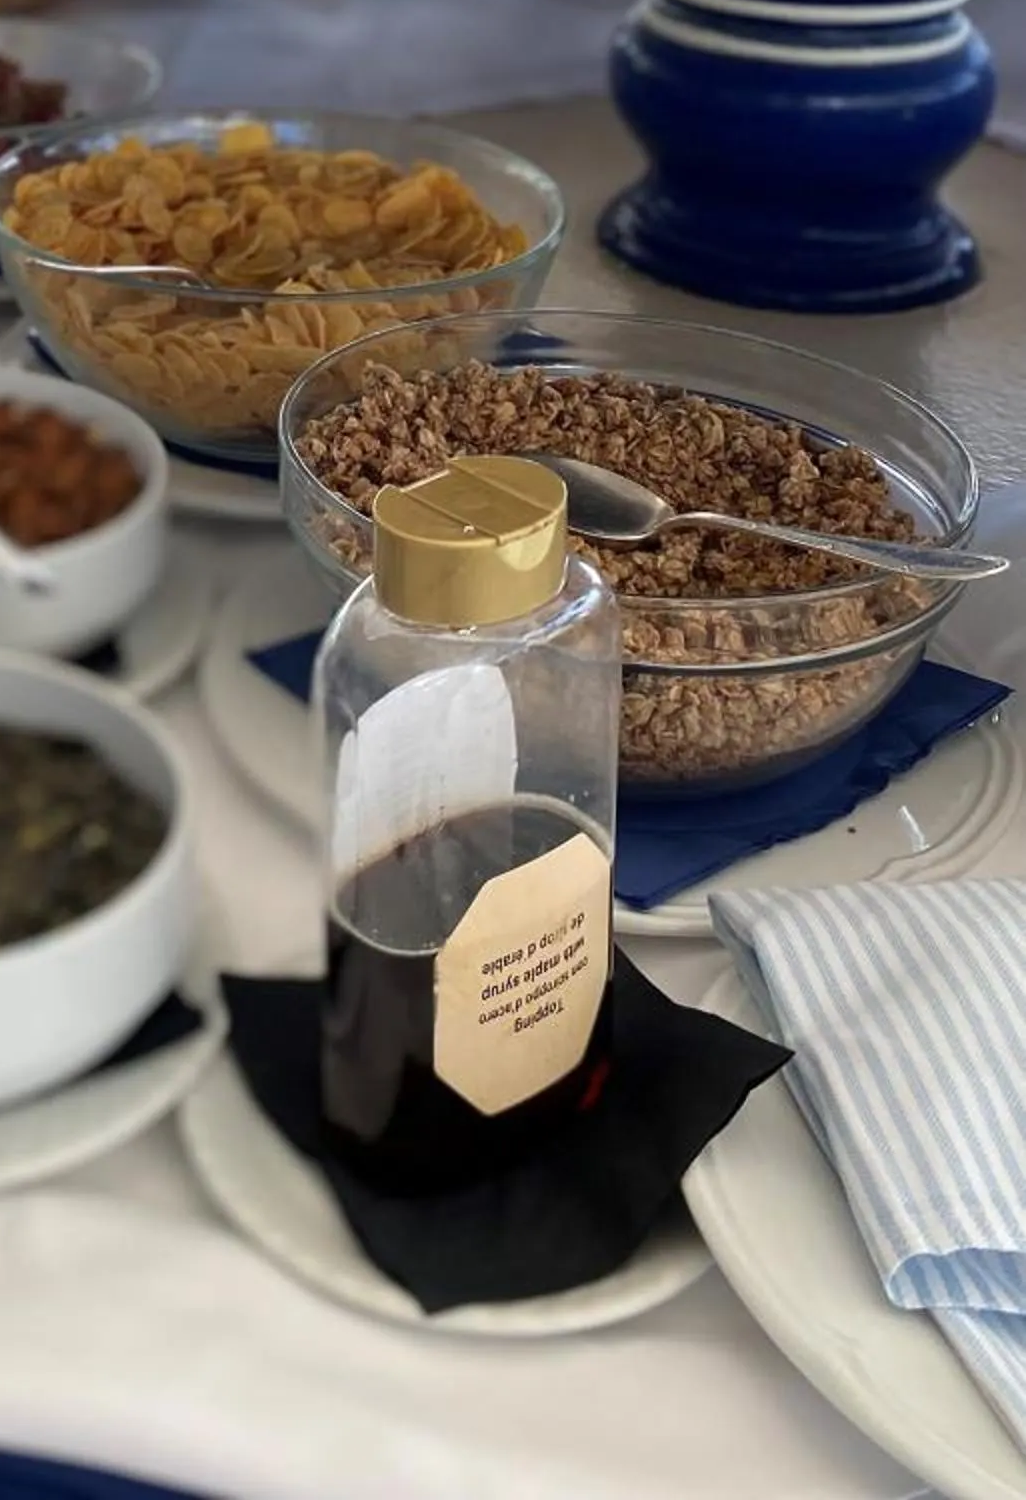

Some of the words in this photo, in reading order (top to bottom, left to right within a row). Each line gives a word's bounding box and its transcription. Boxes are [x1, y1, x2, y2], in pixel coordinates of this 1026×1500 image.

[570, 912, 585, 931] de
[523, 954, 561, 983] maple
[481, 973, 520, 1001] syrup
[478, 996, 523, 1025] d'acero
[513, 998, 565, 1034] Topping
